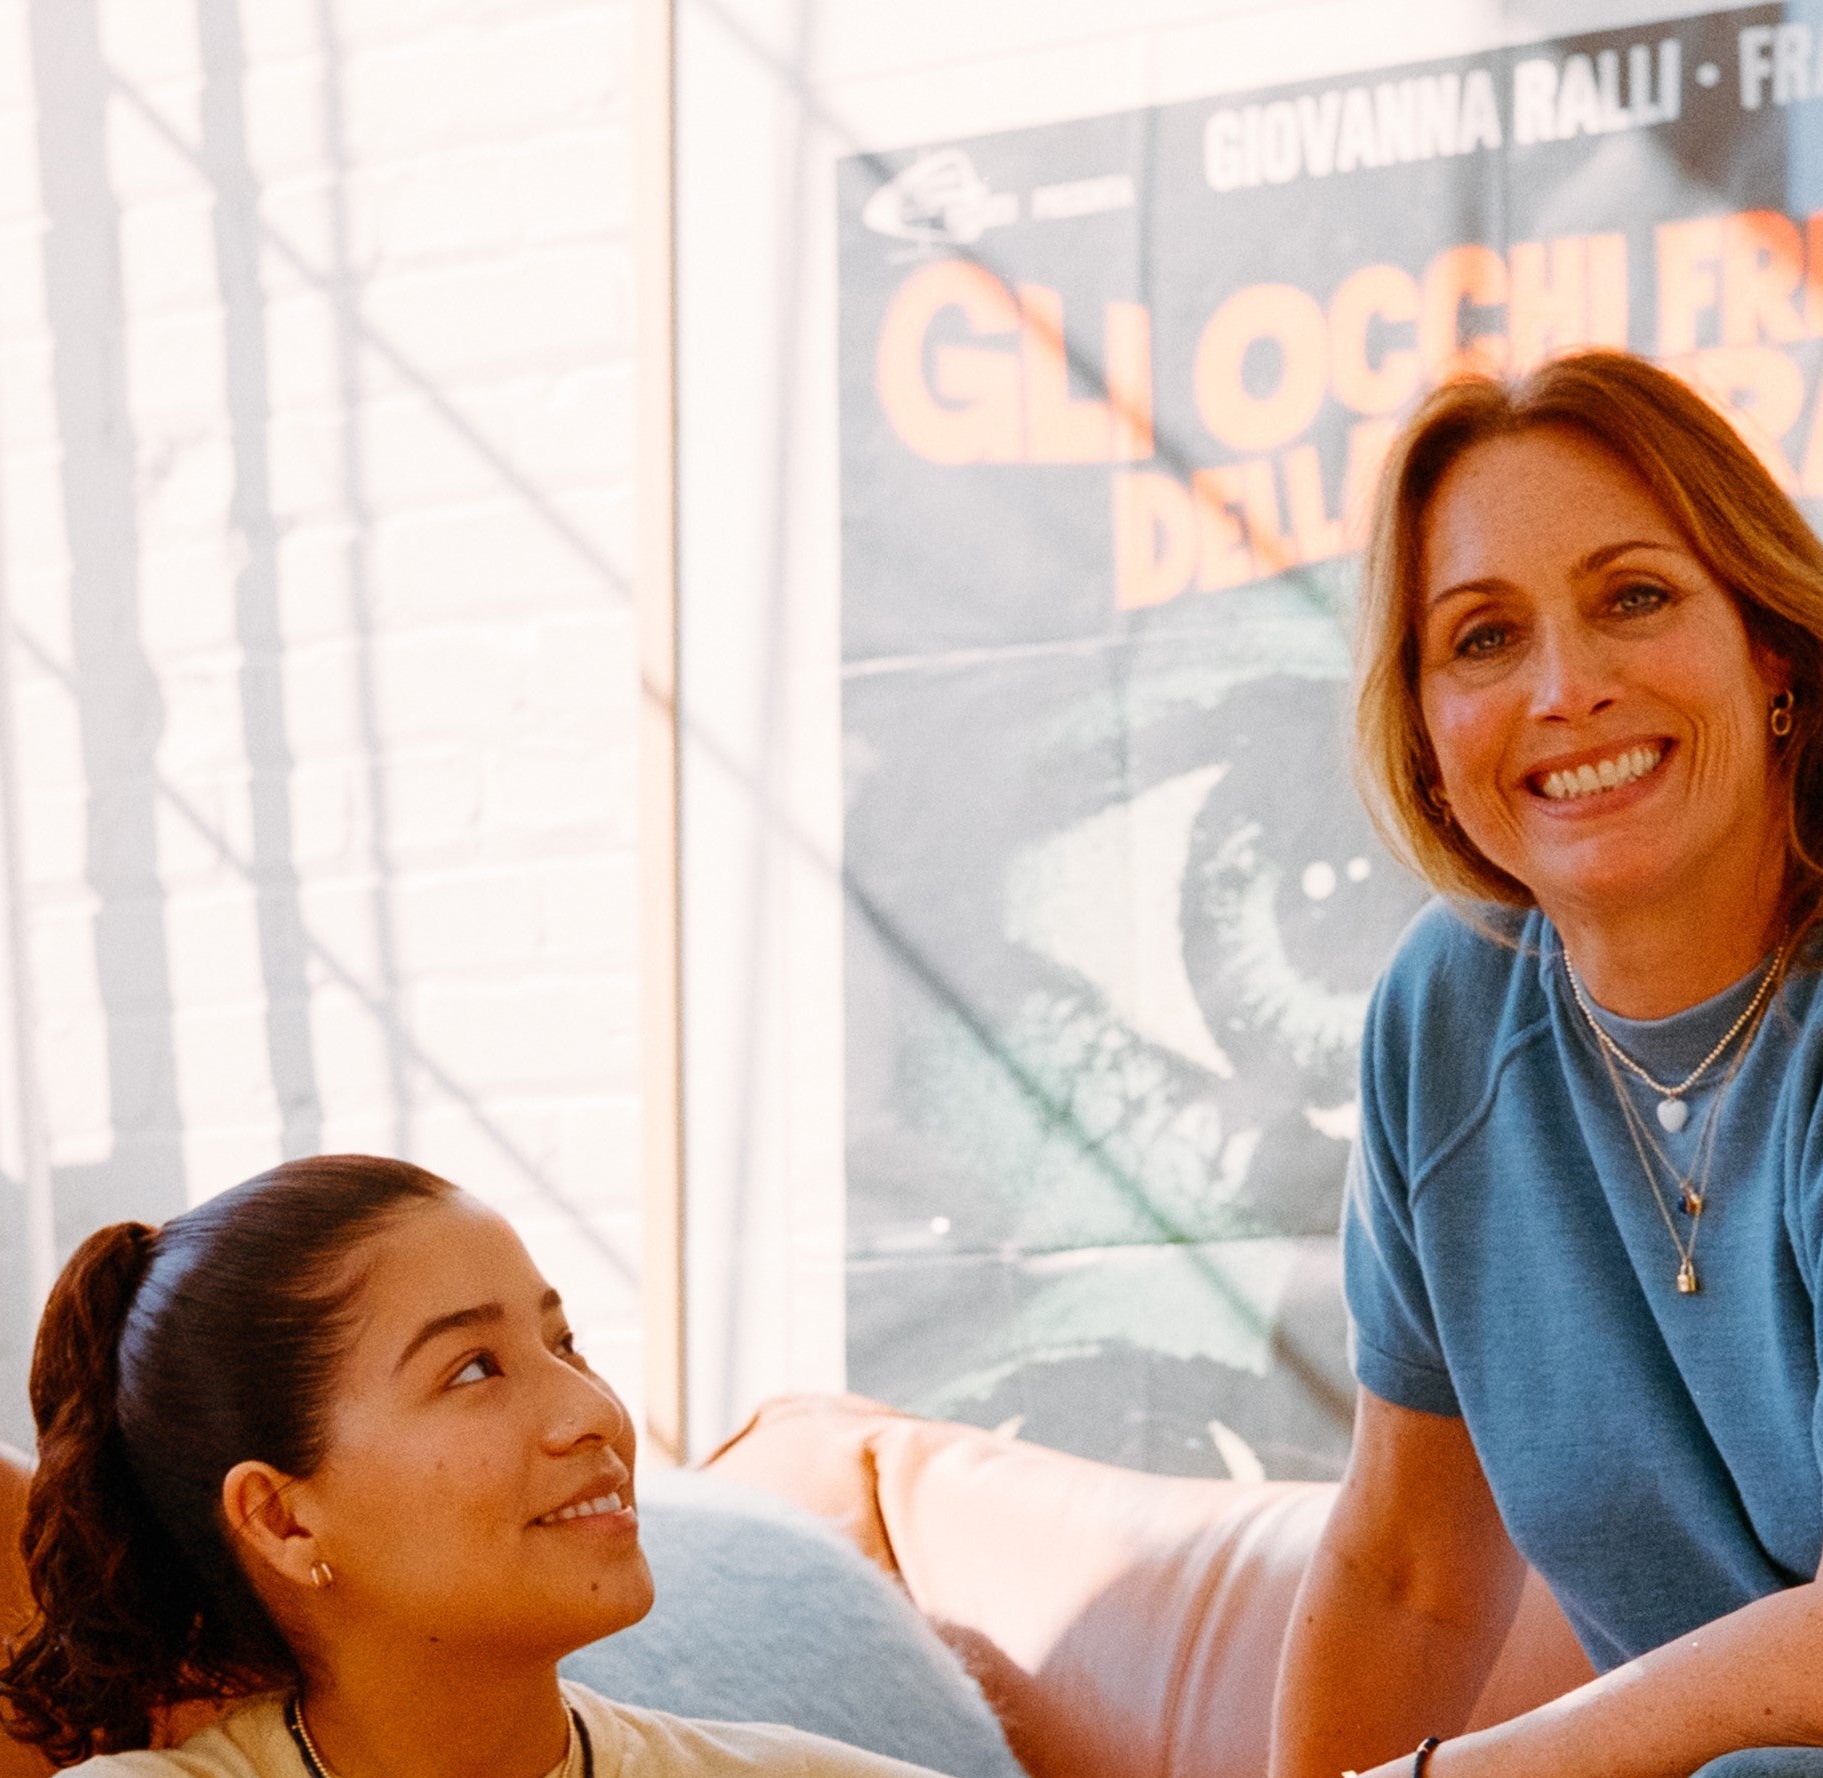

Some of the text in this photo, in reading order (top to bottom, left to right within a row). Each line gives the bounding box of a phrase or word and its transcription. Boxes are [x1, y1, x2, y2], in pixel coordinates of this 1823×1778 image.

[1205, 70, 1501, 191] GIOVANNA
[1512, 38, 1679, 145] RALLI
[877, 261, 1153, 465] GLI
[1194, 234, 1629, 452] OCCHI
